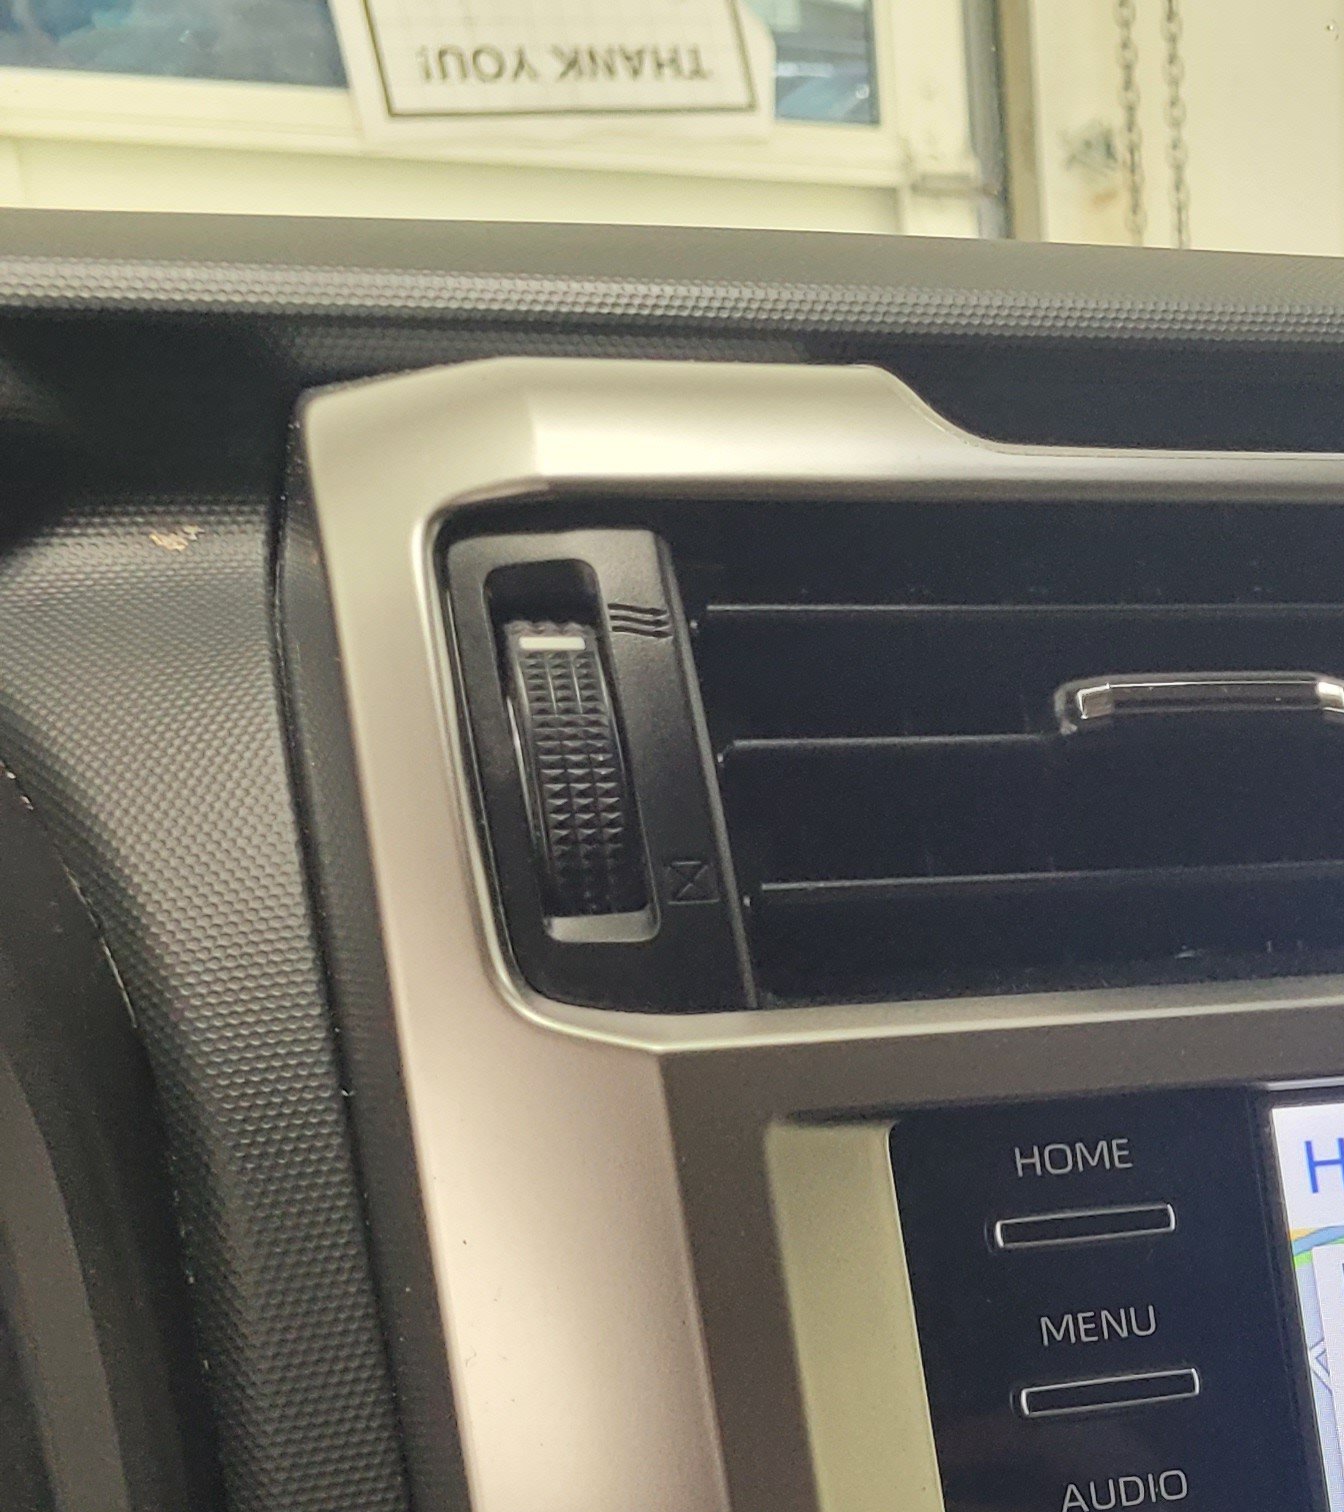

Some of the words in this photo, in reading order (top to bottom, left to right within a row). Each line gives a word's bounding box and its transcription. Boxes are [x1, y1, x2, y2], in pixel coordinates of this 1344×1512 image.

[551, 43, 713, 83] THANK
[1014, 1137, 1133, 1178] HOME
[1039, 1304, 1158, 1347] MENU
